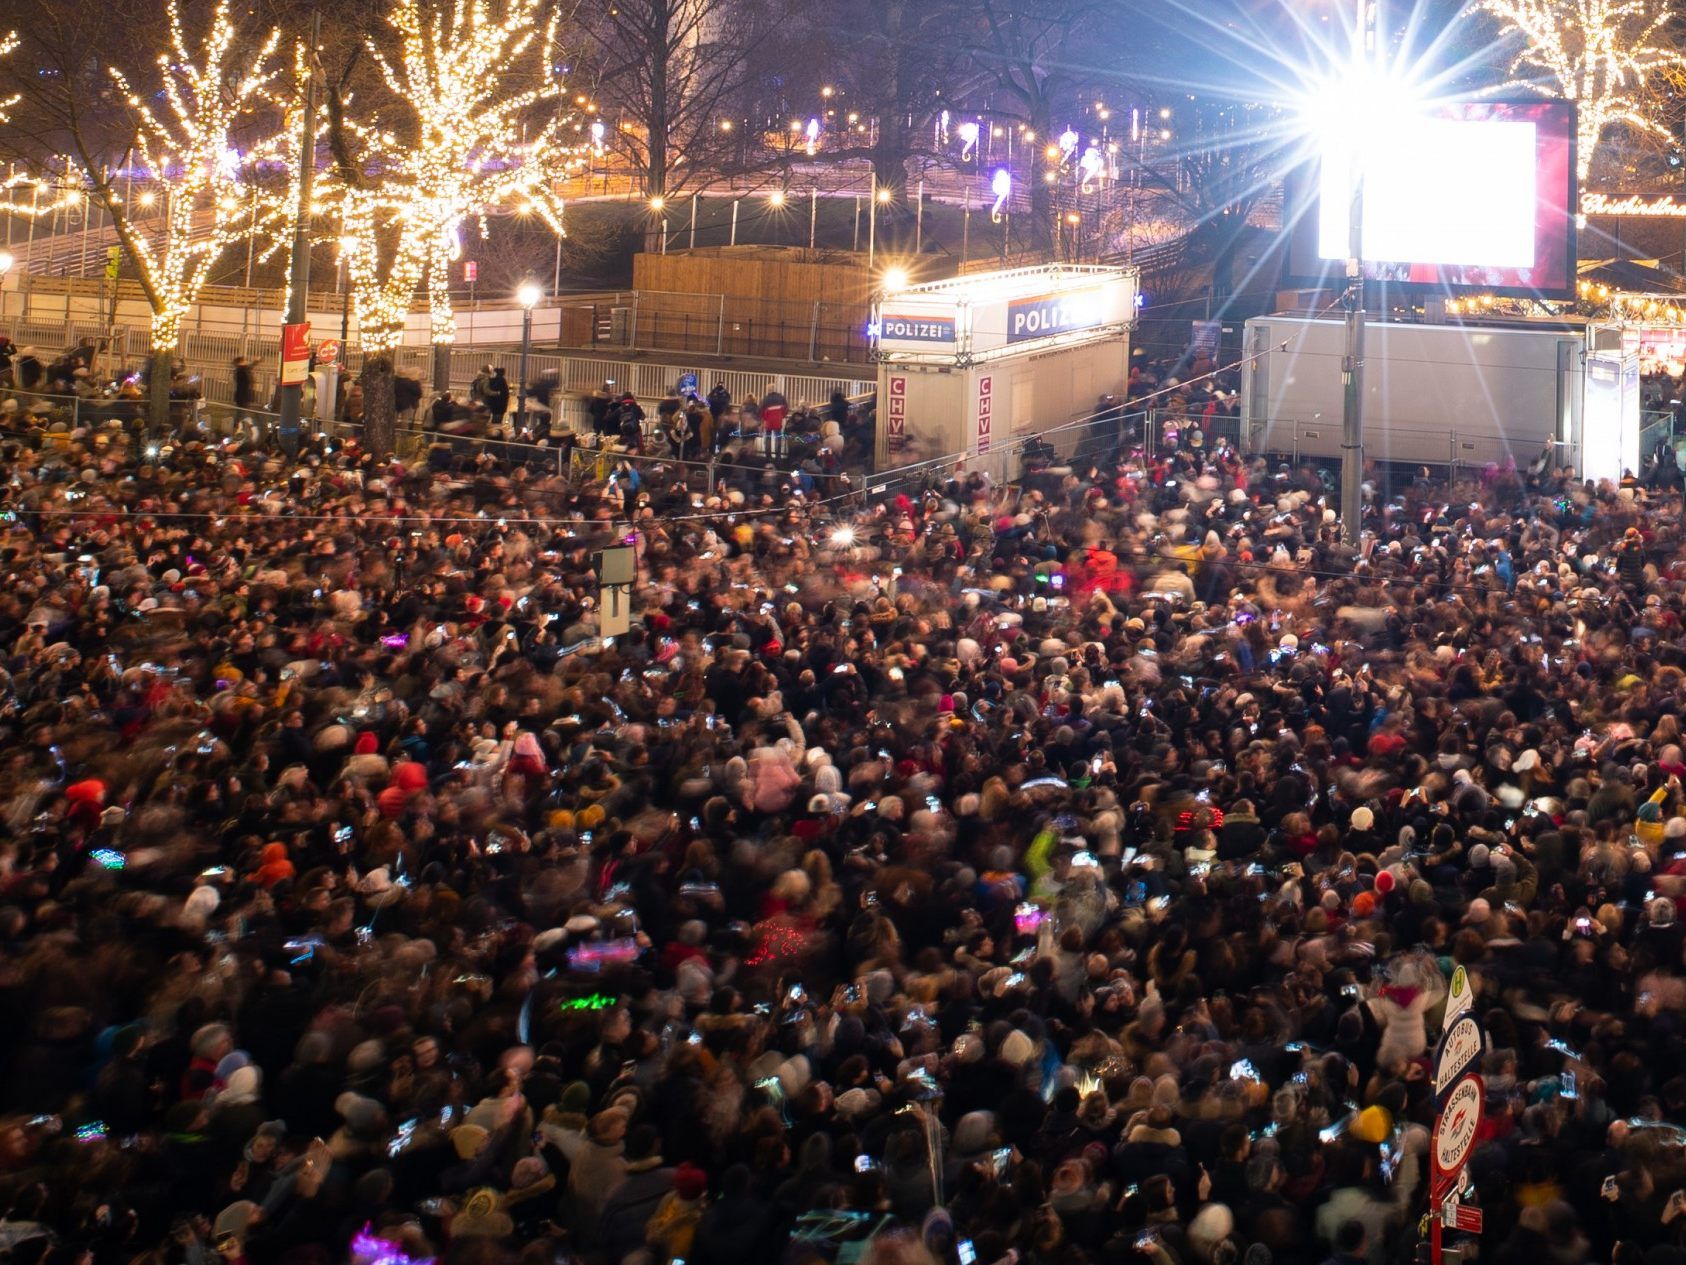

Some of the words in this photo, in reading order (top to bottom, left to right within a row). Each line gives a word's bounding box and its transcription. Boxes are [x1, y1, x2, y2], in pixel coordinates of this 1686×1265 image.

[886, 322, 942, 338] POLIZEI
[1445, 1022, 1473, 1058] AUTOBUS
[1439, 1040, 1478, 1089] HALTESTELLE
[1440, 1084, 1477, 1135] STRASSENBAHN
[1440, 1118, 1476, 1164] HALTESTELLE
